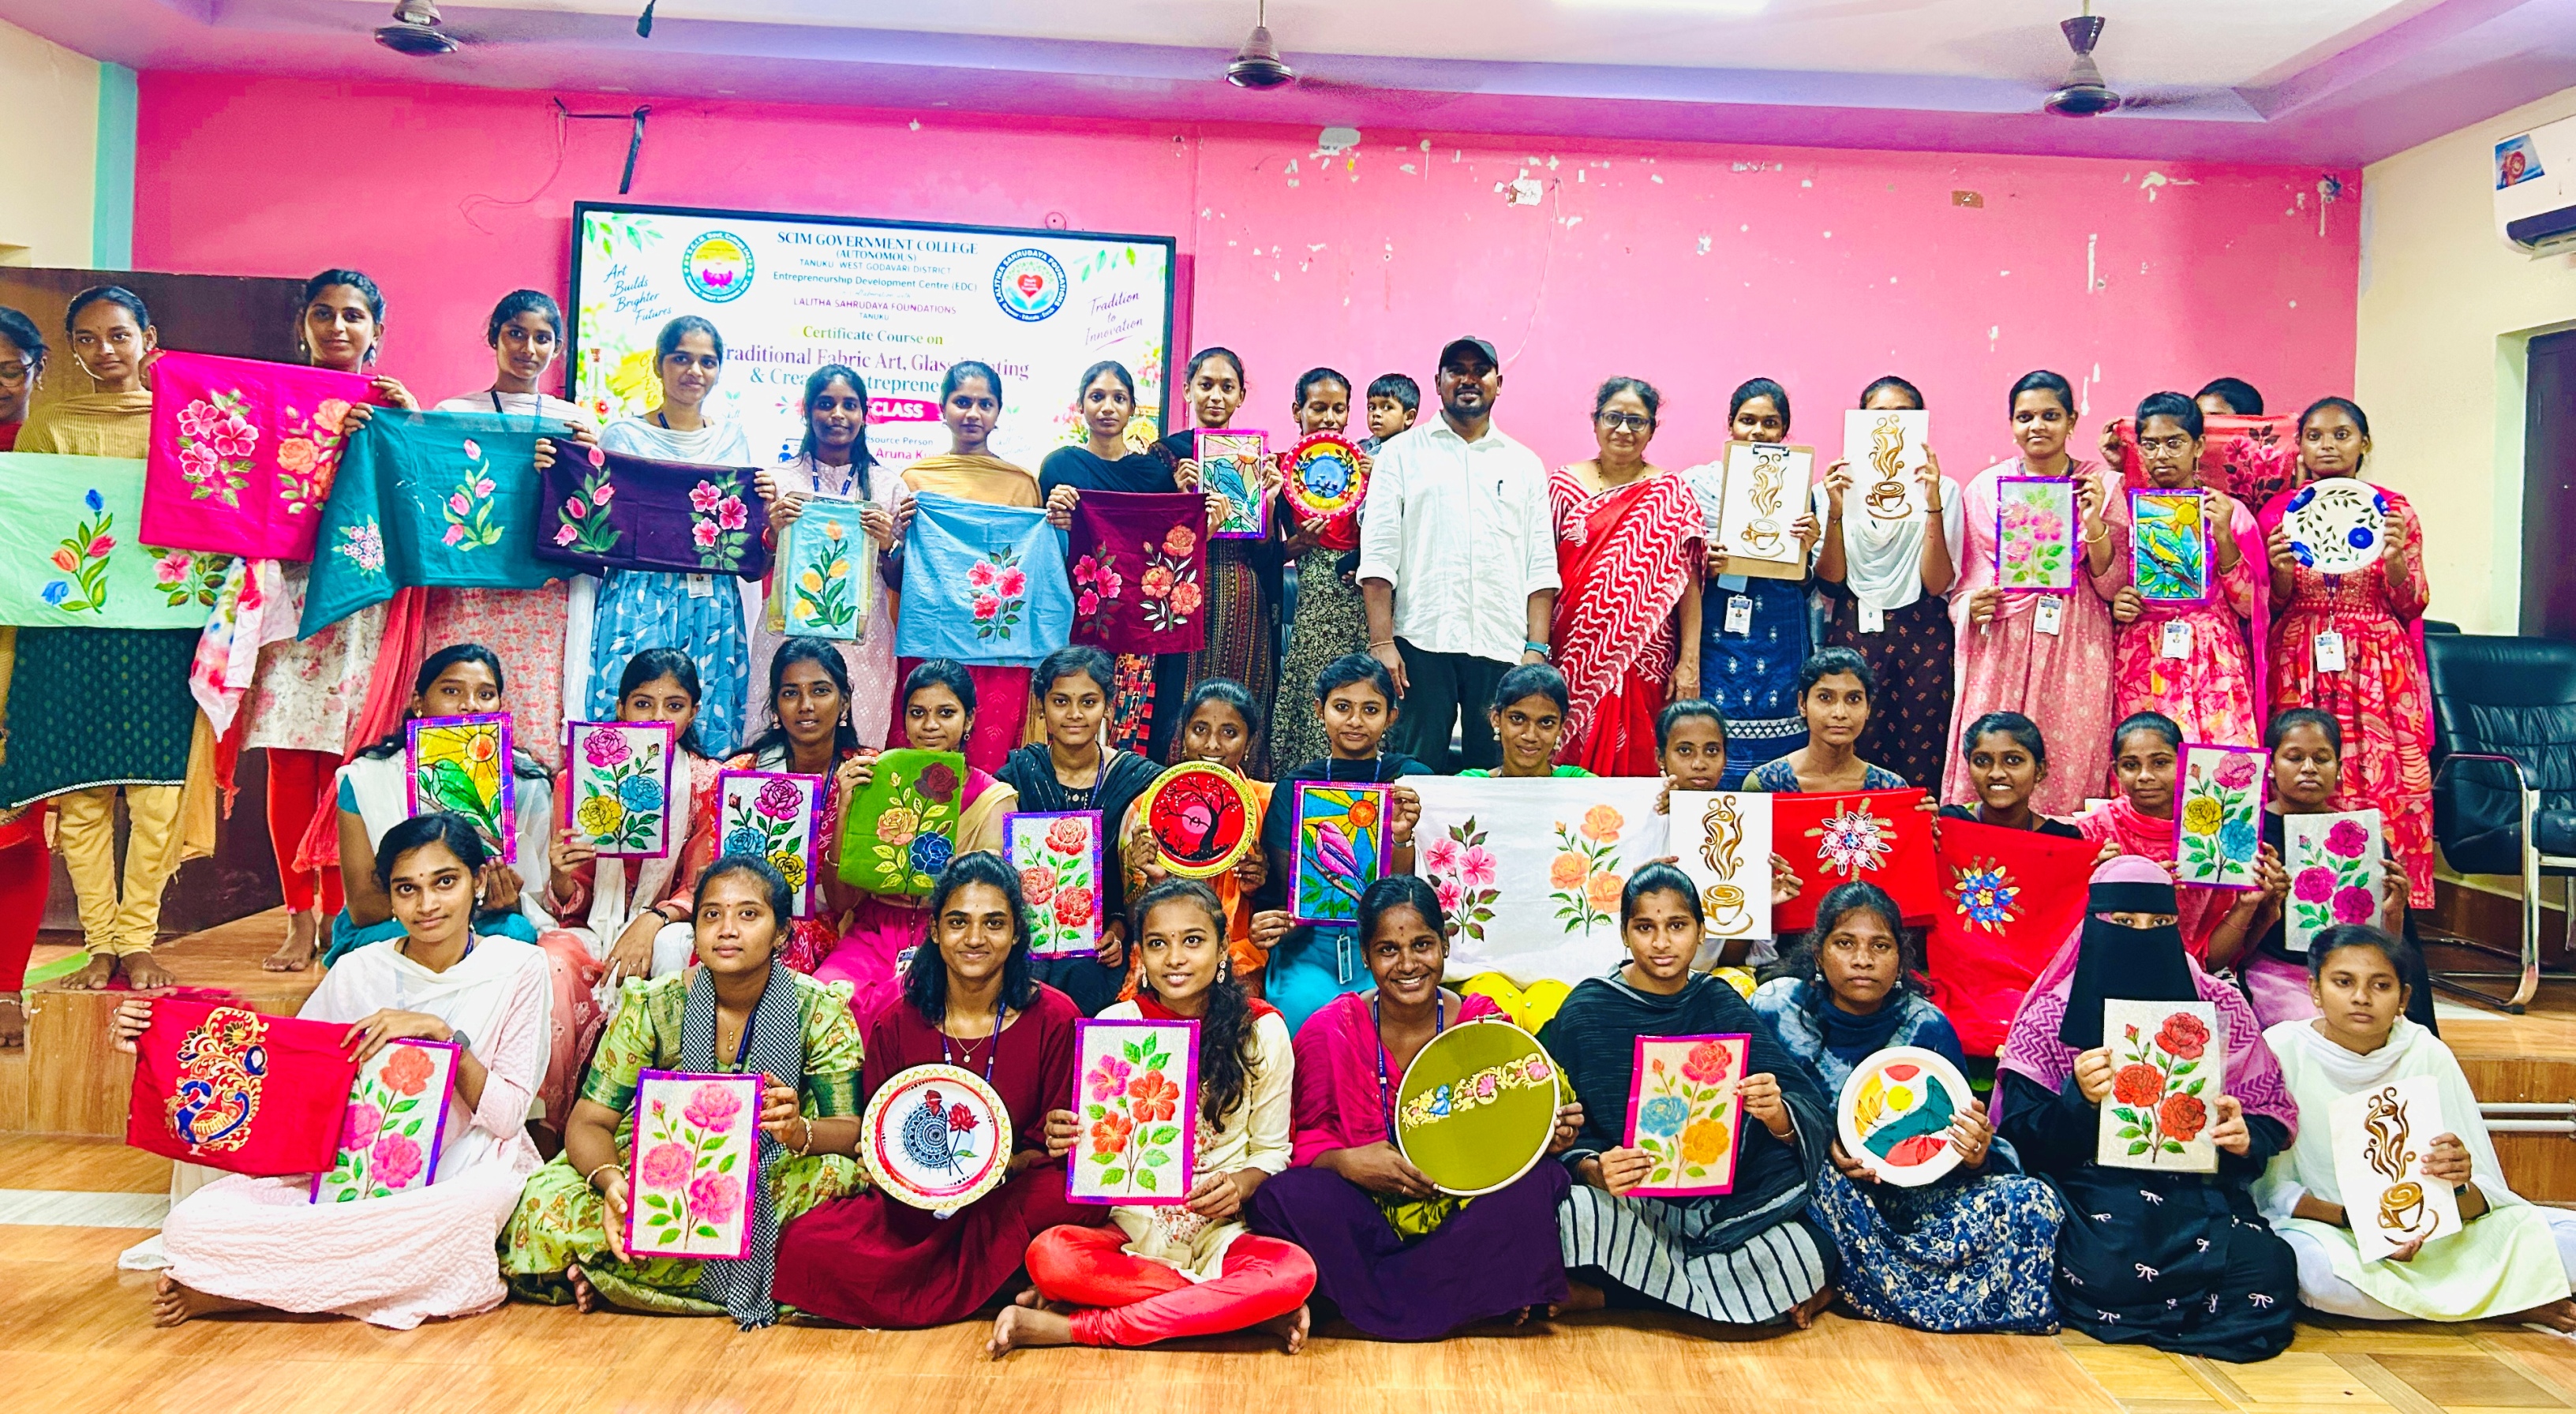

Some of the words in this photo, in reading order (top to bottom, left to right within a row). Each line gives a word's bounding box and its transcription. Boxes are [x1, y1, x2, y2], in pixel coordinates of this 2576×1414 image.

[777, 232, 812, 245] SCIM
[816, 234, 913, 251] GOVERNMENT
[917, 240, 978, 255] COLLEGE
[837, 249, 917, 262] (AUTONOMOUS)
[603, 264, 627, 282] Art
[866, 263, 910, 272] GODAVARI
[913, 265, 951, 275] DISTRICT
[994, 266, 1005, 303] LALITHA
[1002, 249, 1048, 267] SAHRUDAYA
[1047, 257, 1065, 307] FOUNDATIONS
[609, 275, 648, 297] Builds
[773, 271, 852, 285] Entrepreneurship
[856, 276, 915, 289] Development
[919, 279, 949, 290] Centre
[952, 282, 977, 293] (EDC)
[614, 291, 660, 312] Brighter
[793, 297, 831, 306] LALITHA
[835, 300, 888, 310] SAHRUDAYA
[892, 303, 957, 314] FOUNDATIONS
[1088, 291, 1139, 316] Tradition
[635, 307, 672, 326] Futures
[1107, 312, 1116, 323] to
[803, 325, 874, 341] Certificate
[878, 330, 923, 344] Course
[927, 335, 943, 345] on
[1086, 318, 1143, 346] Innovation
[723, 343, 811, 364] raditional
[818, 349, 871, 368] Fabric
[875, 352, 907, 372] Art,
[750, 367, 765, 383] &
[770, 368, 808, 385] Crea
[867, 376, 939, 395] treprene
[871, 401, 923, 419] CLASS
[903, 437, 933, 446] Person
[876, 447, 912, 460] Aruna
